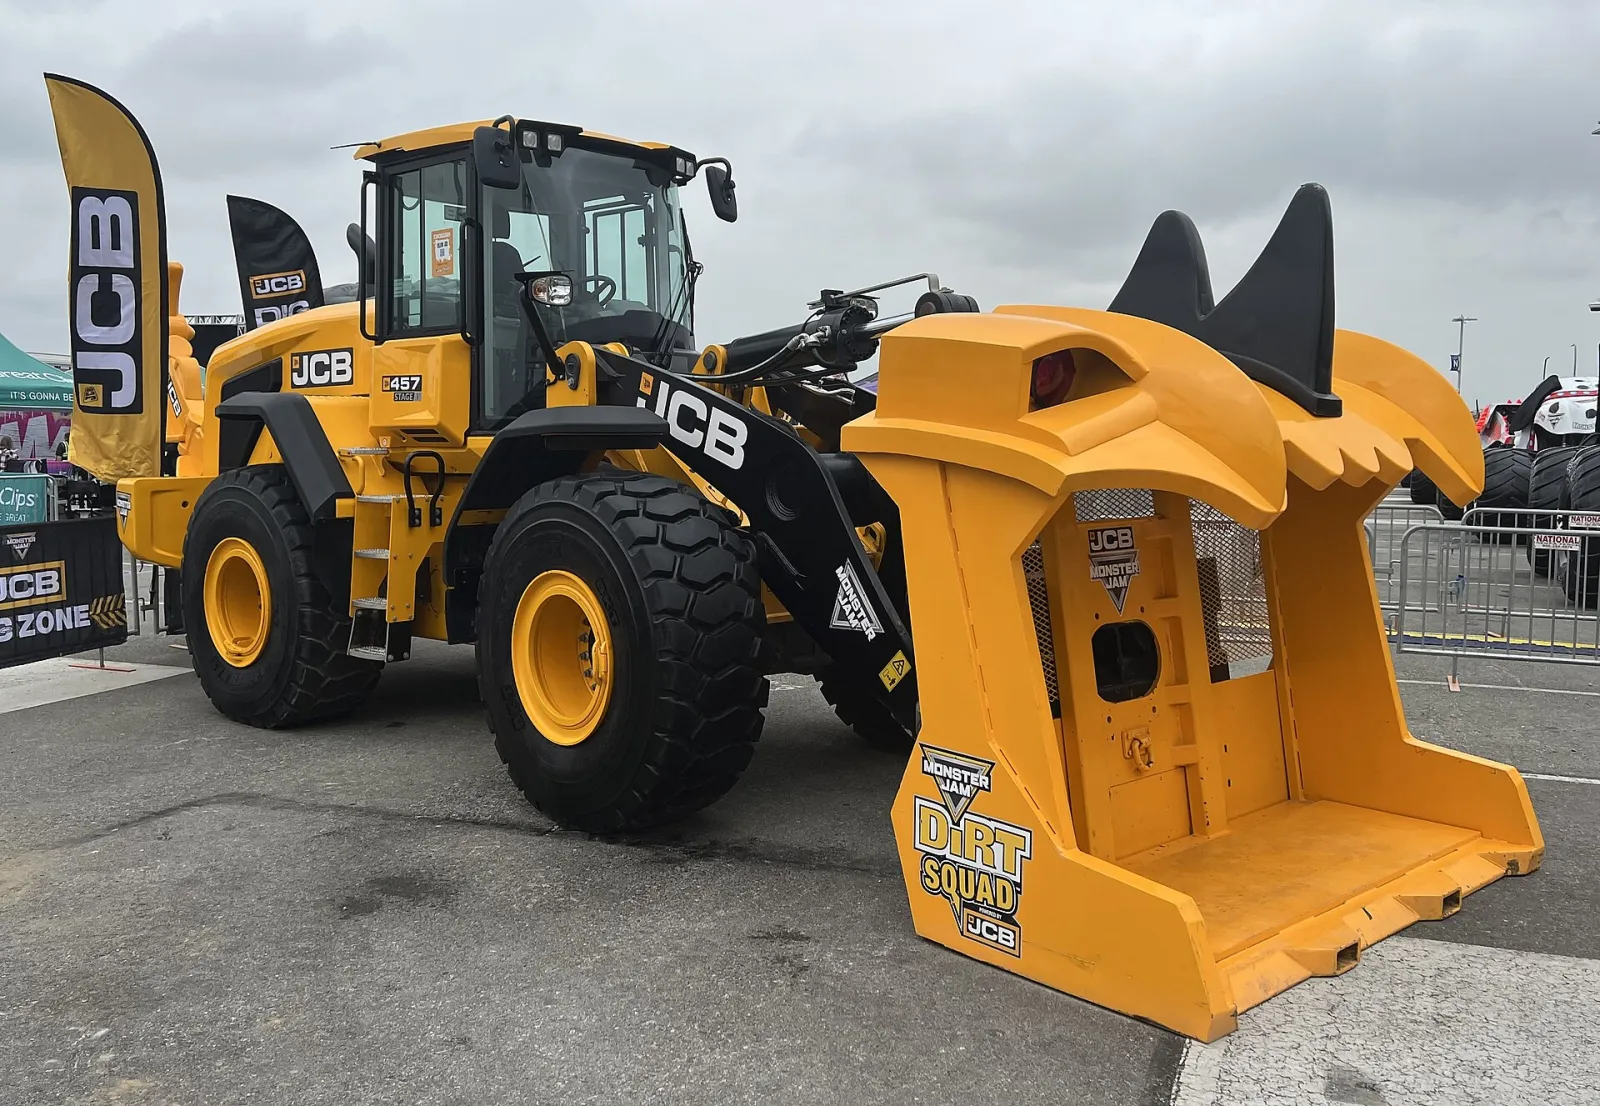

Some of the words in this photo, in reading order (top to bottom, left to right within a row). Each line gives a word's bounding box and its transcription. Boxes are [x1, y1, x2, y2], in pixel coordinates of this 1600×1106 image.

[256, 275, 302, 294] JCB
[76, 196, 136, 408] JCB
[292, 351, 353, 386] JCB
[390, 376, 420, 391] 457
[10, 391, 26, 400] IT'S
[29, 391, 60, 401] GONNA
[394, 392, 414, 401] STAGE
[0, 487, 35, 511] Clips
[1090, 528, 1133, 551] JCB
[1536, 535, 1579, 544] NATIONAL
[1090, 562, 1139, 578] MONSTER
[1106, 575, 1128, 589] JAM
[835, 565, 877, 642] MONSTER
[838, 595, 861, 629] JAM
[18, 604, 91, 638] ZONE
[923, 759, 990, 790] MONSTER
[941, 779, 972, 798] JAM
[924, 857, 1015, 920] SQUAD
[967, 917, 1015, 948] JCB
